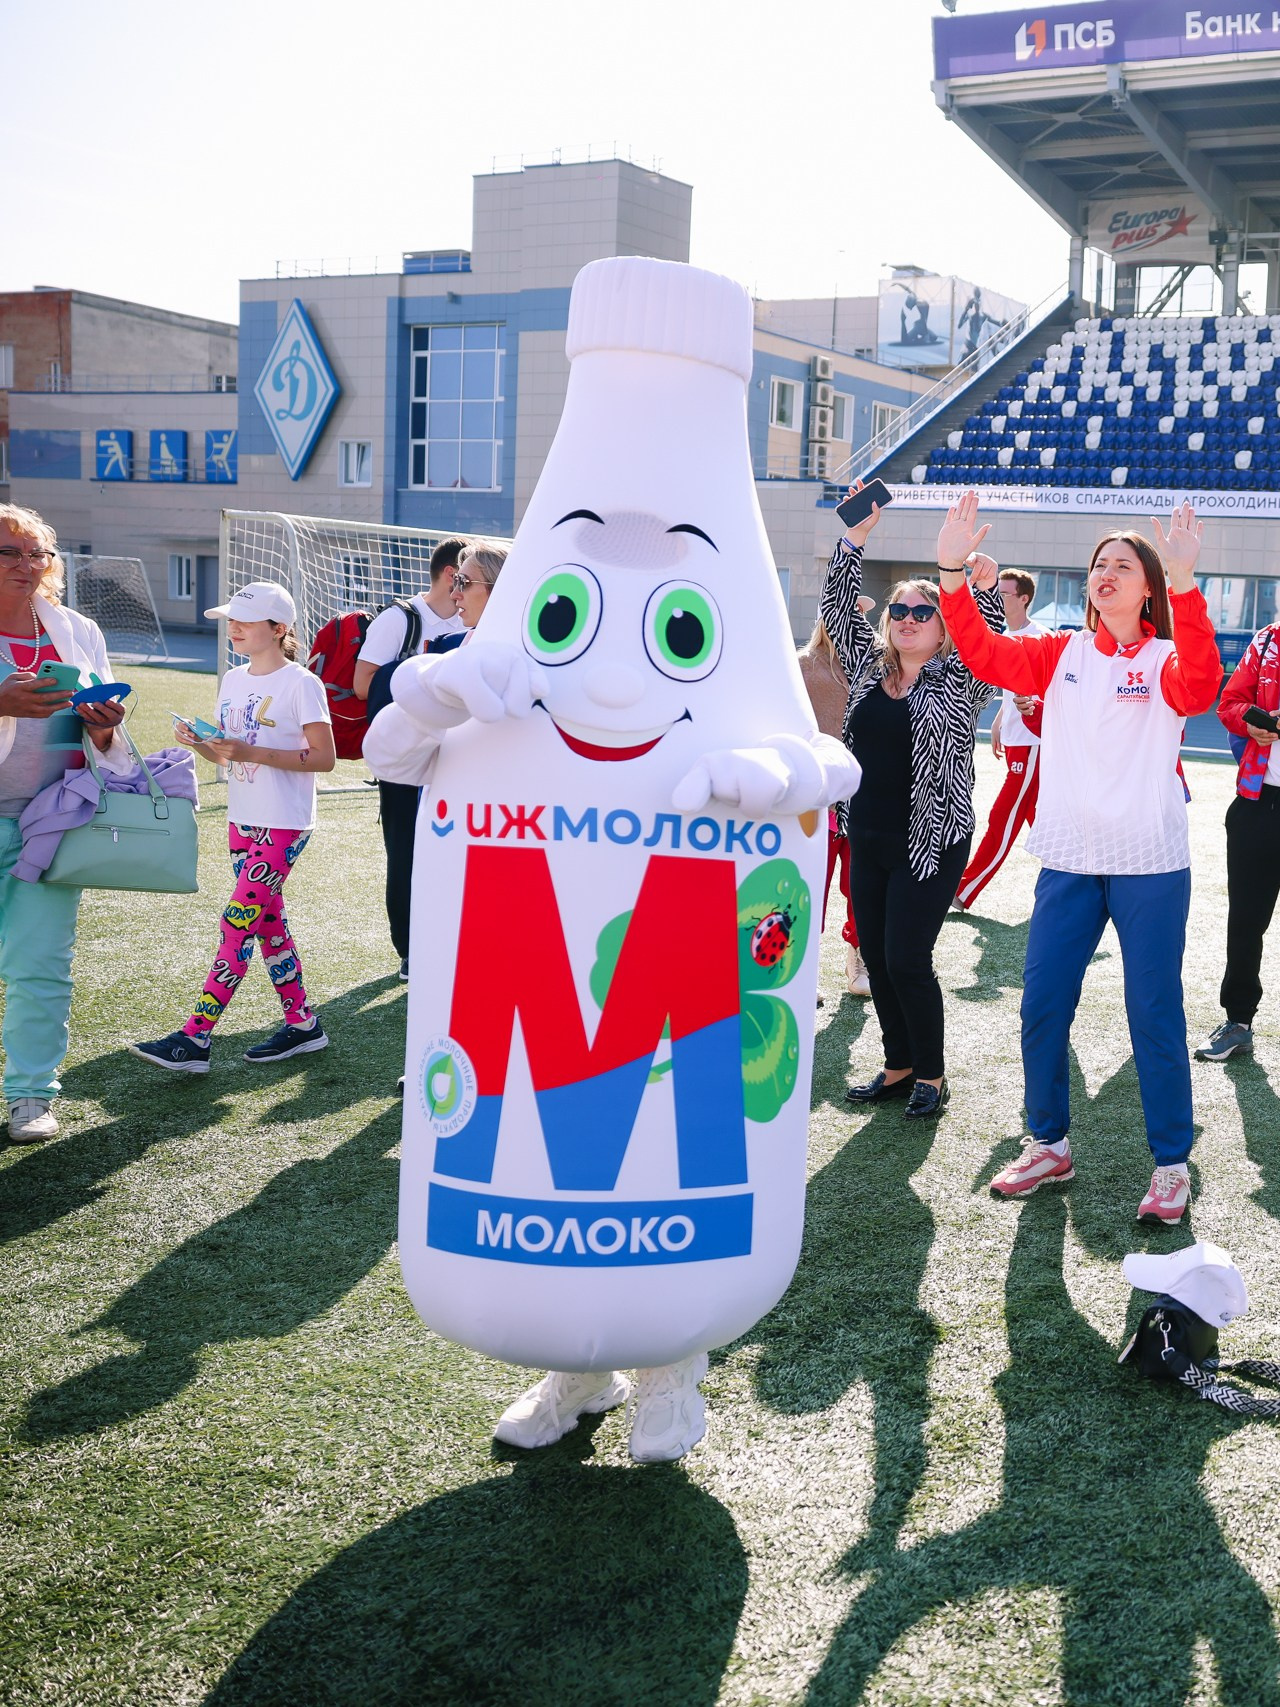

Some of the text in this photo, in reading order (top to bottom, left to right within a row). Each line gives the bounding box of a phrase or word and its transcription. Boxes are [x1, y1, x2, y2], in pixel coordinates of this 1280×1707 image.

[1054, 19, 1116, 51] ПСБ
[1185, 11, 1263, 40] Банк
[890, 490, 979, 501] ПРИВЕТСТВУ
[986, 491, 1069, 504] УЧАСТНИКОВ
[1076, 493, 1175, 508] СПАРТАКИАДЫ
[1011, 761, 1024, 772] 20
[438, 1038, 474, 1092] МОЛОЧНЫЕ
[432, 1100, 472, 1134] ПРОДУКТЫ
[476, 1209, 696, 1255] МОЛОКО
